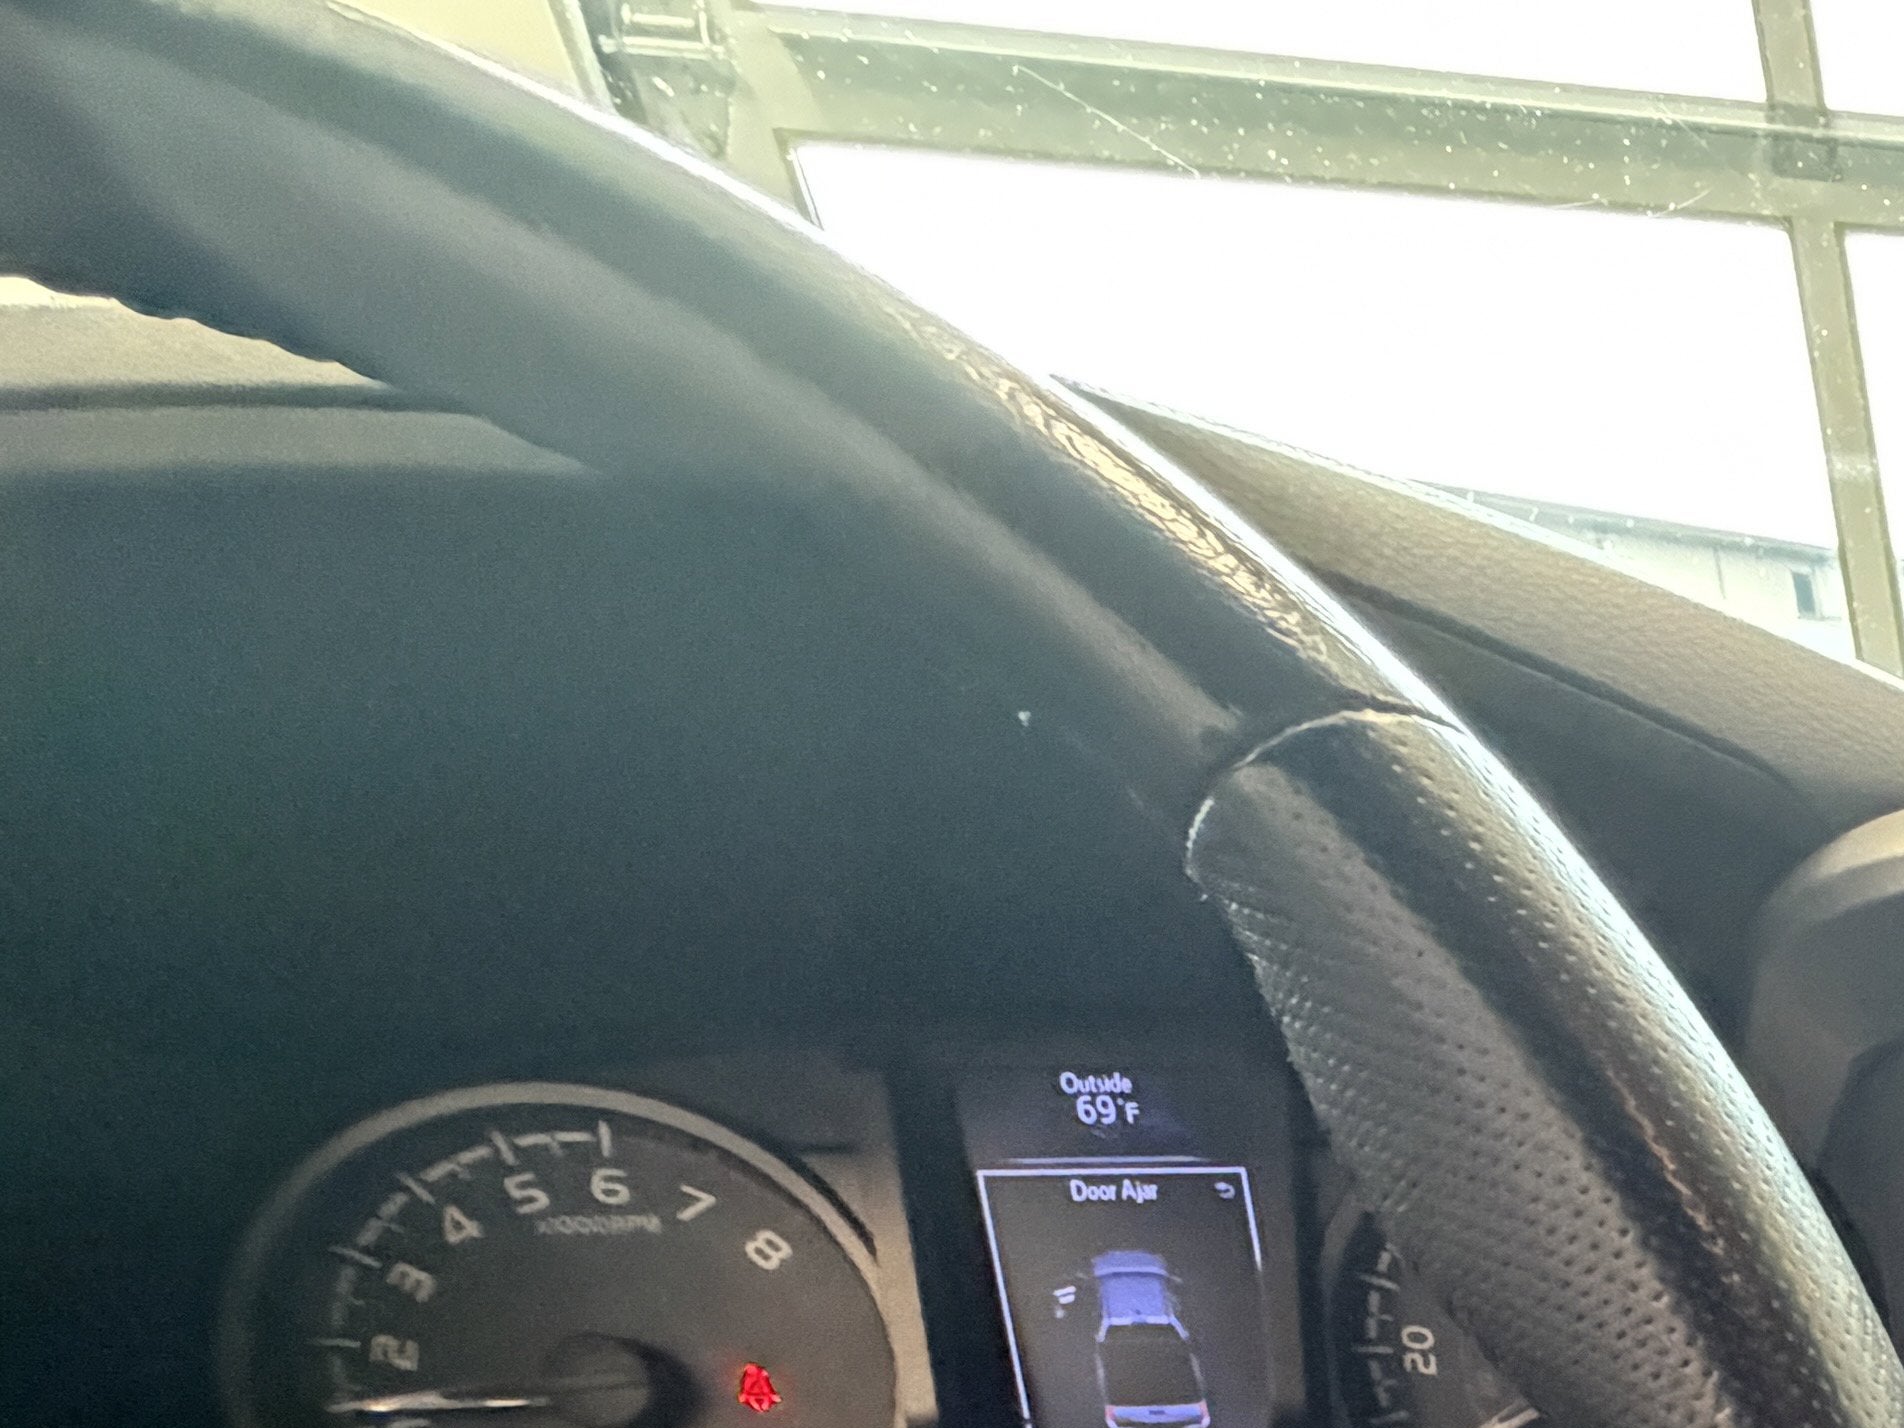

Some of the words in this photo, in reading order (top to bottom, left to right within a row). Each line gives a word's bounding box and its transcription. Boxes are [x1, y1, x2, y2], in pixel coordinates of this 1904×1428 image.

[1059, 1071, 1132, 1095] Outside
[503, 1172, 550, 1214] 5
[590, 1168, 630, 1205] 6
[676, 1184, 716, 1221] 7
[1069, 1178, 1117, 1202] Door
[1121, 1177, 1158, 1204] Ajar
[441, 1205, 484, 1245] 4
[744, 1229, 793, 1270] 8
[387, 1262, 438, 1302] 3
[1401, 1325, 1438, 1377] 20
